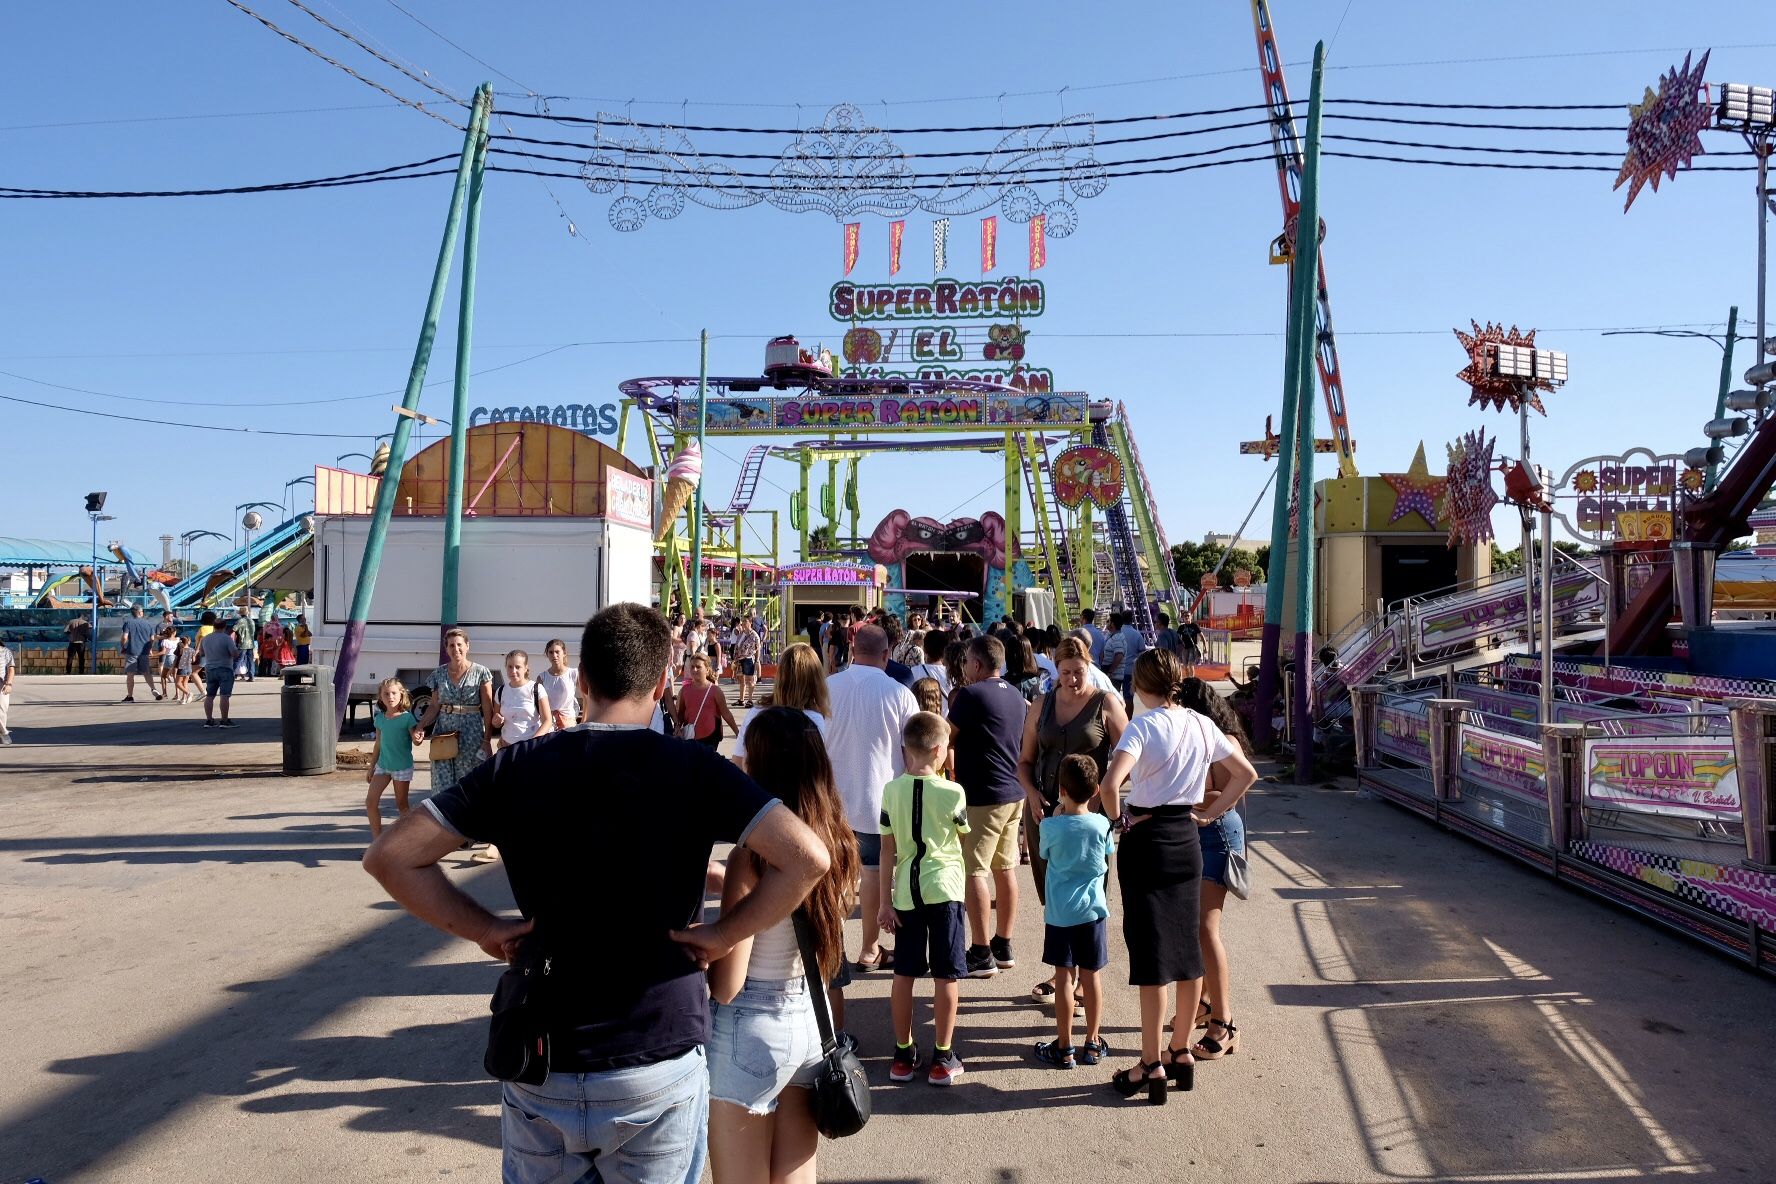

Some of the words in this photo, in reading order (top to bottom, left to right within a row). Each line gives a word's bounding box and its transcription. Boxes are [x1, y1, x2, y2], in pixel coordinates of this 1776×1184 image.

[915, 331, 959, 358] EL
[470, 403, 618, 436] CATARATAS
[782, 401, 875, 425] SUPER
[1601, 465, 1675, 496] SUPER
[793, 568, 823, 582] SUPER
